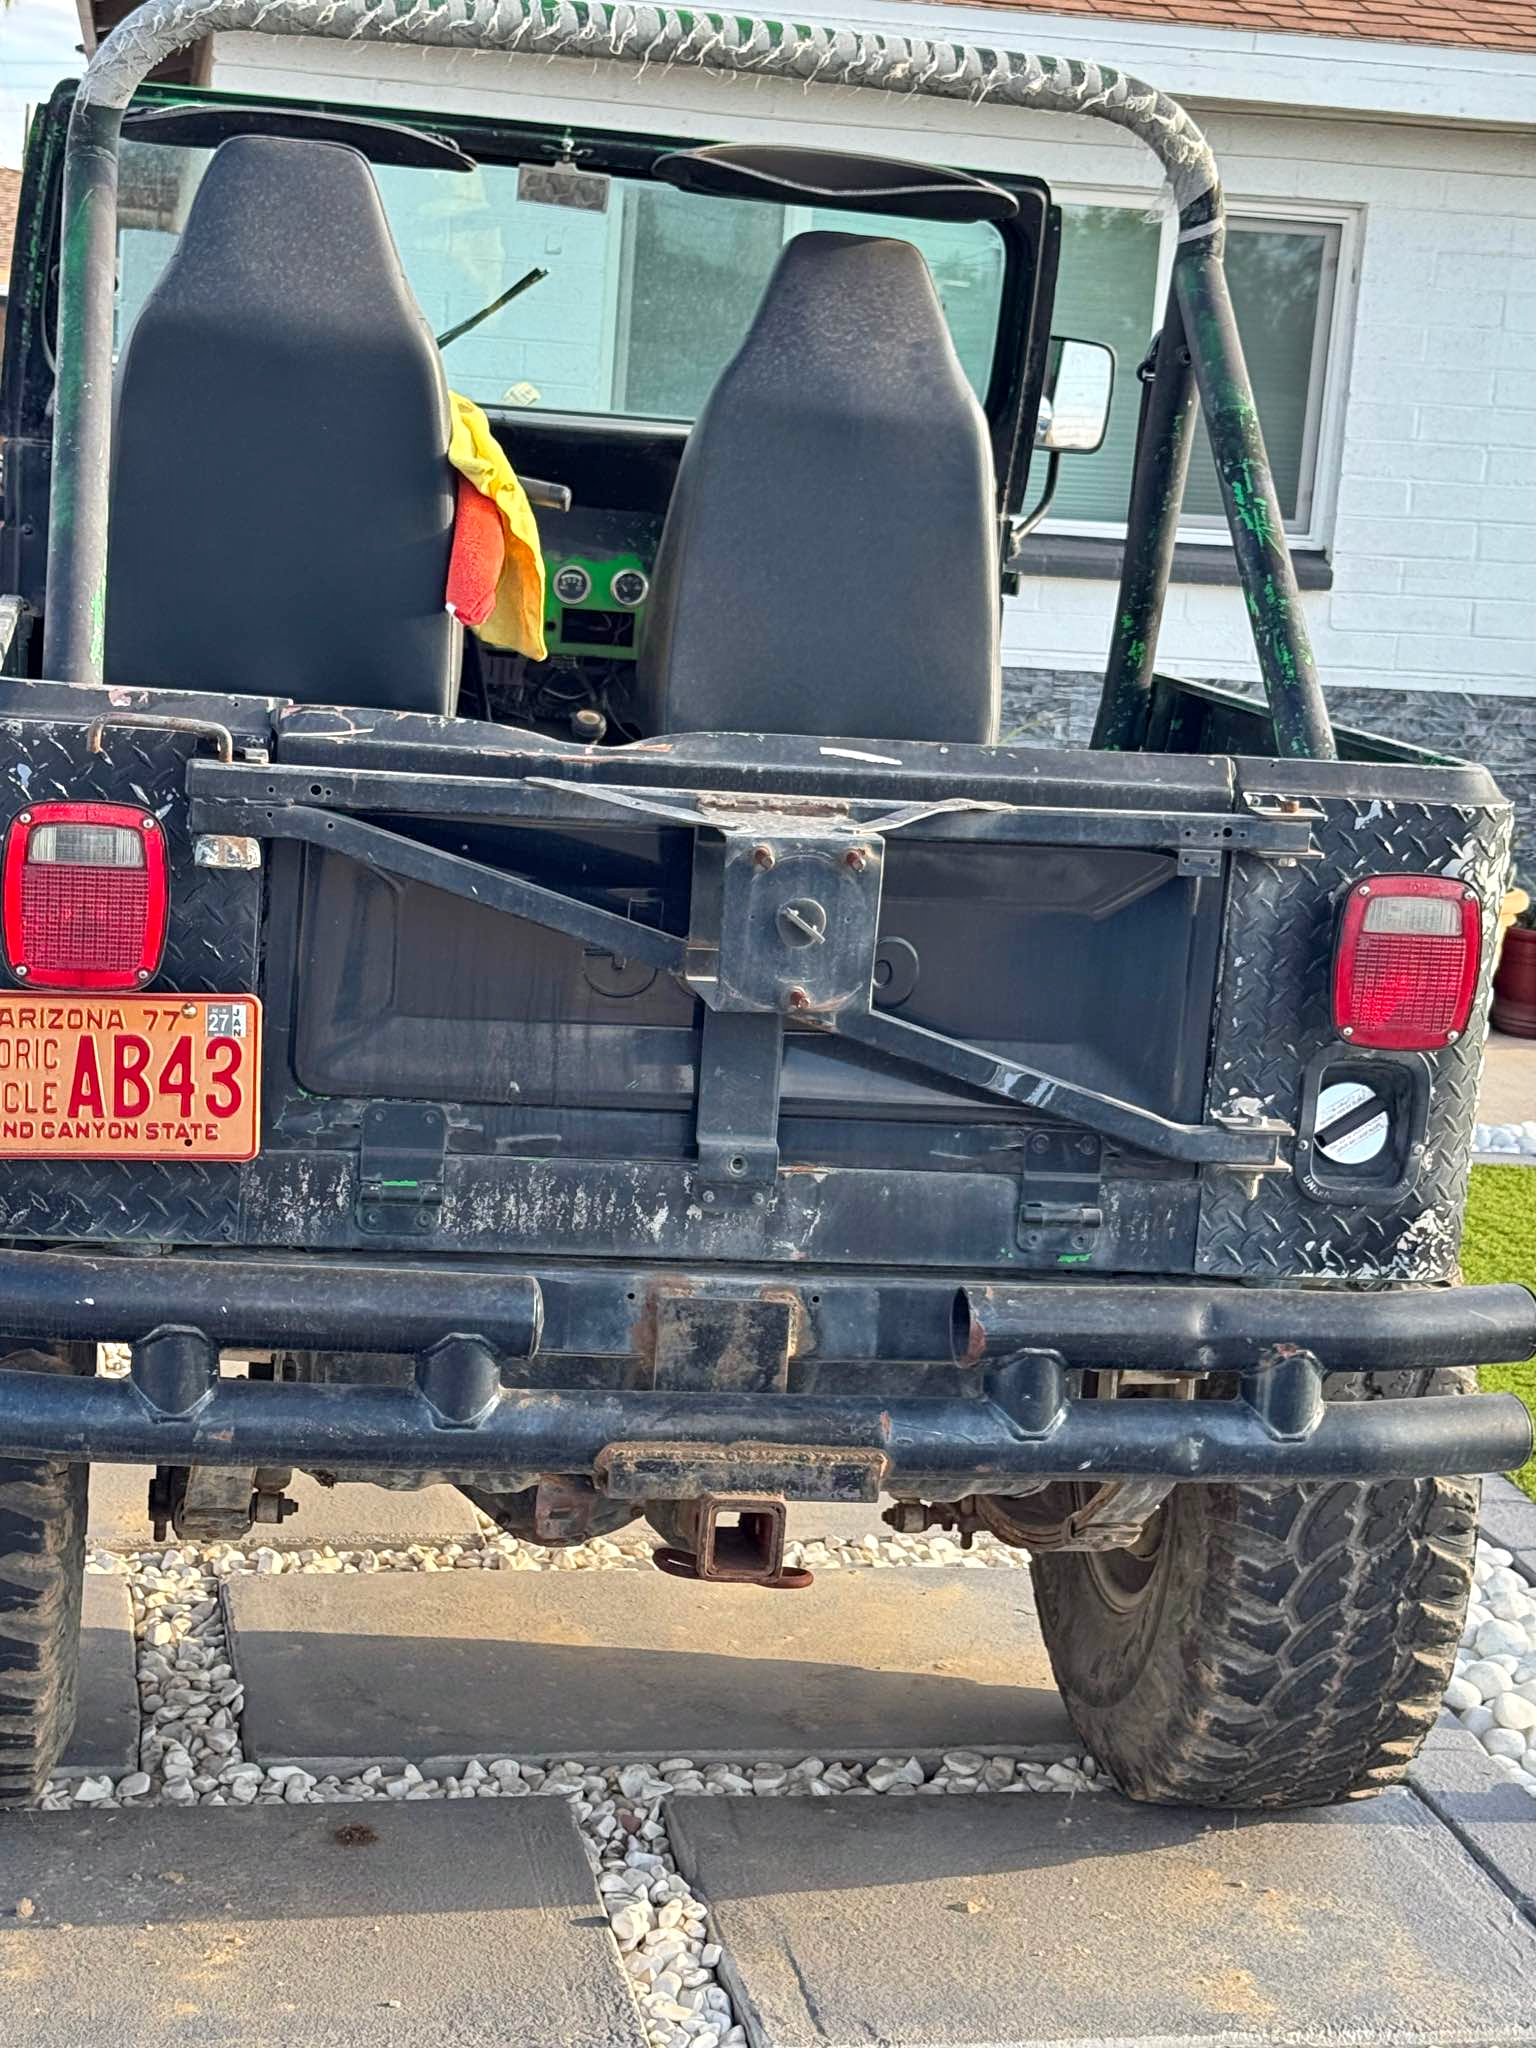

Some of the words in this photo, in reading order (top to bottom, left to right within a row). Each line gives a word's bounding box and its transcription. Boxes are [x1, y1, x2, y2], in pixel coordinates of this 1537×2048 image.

[0, 1007, 124, 1030] ARIZONA
[142, 1009, 181, 1031] 77
[208, 1013, 230, 1032] 27
[232, 1008, 242, 1037] JAN
[67, 1034, 243, 1119] AB43
[41, 1121, 138, 1140] CANYON
[145, 1122, 219, 1141] STATE
